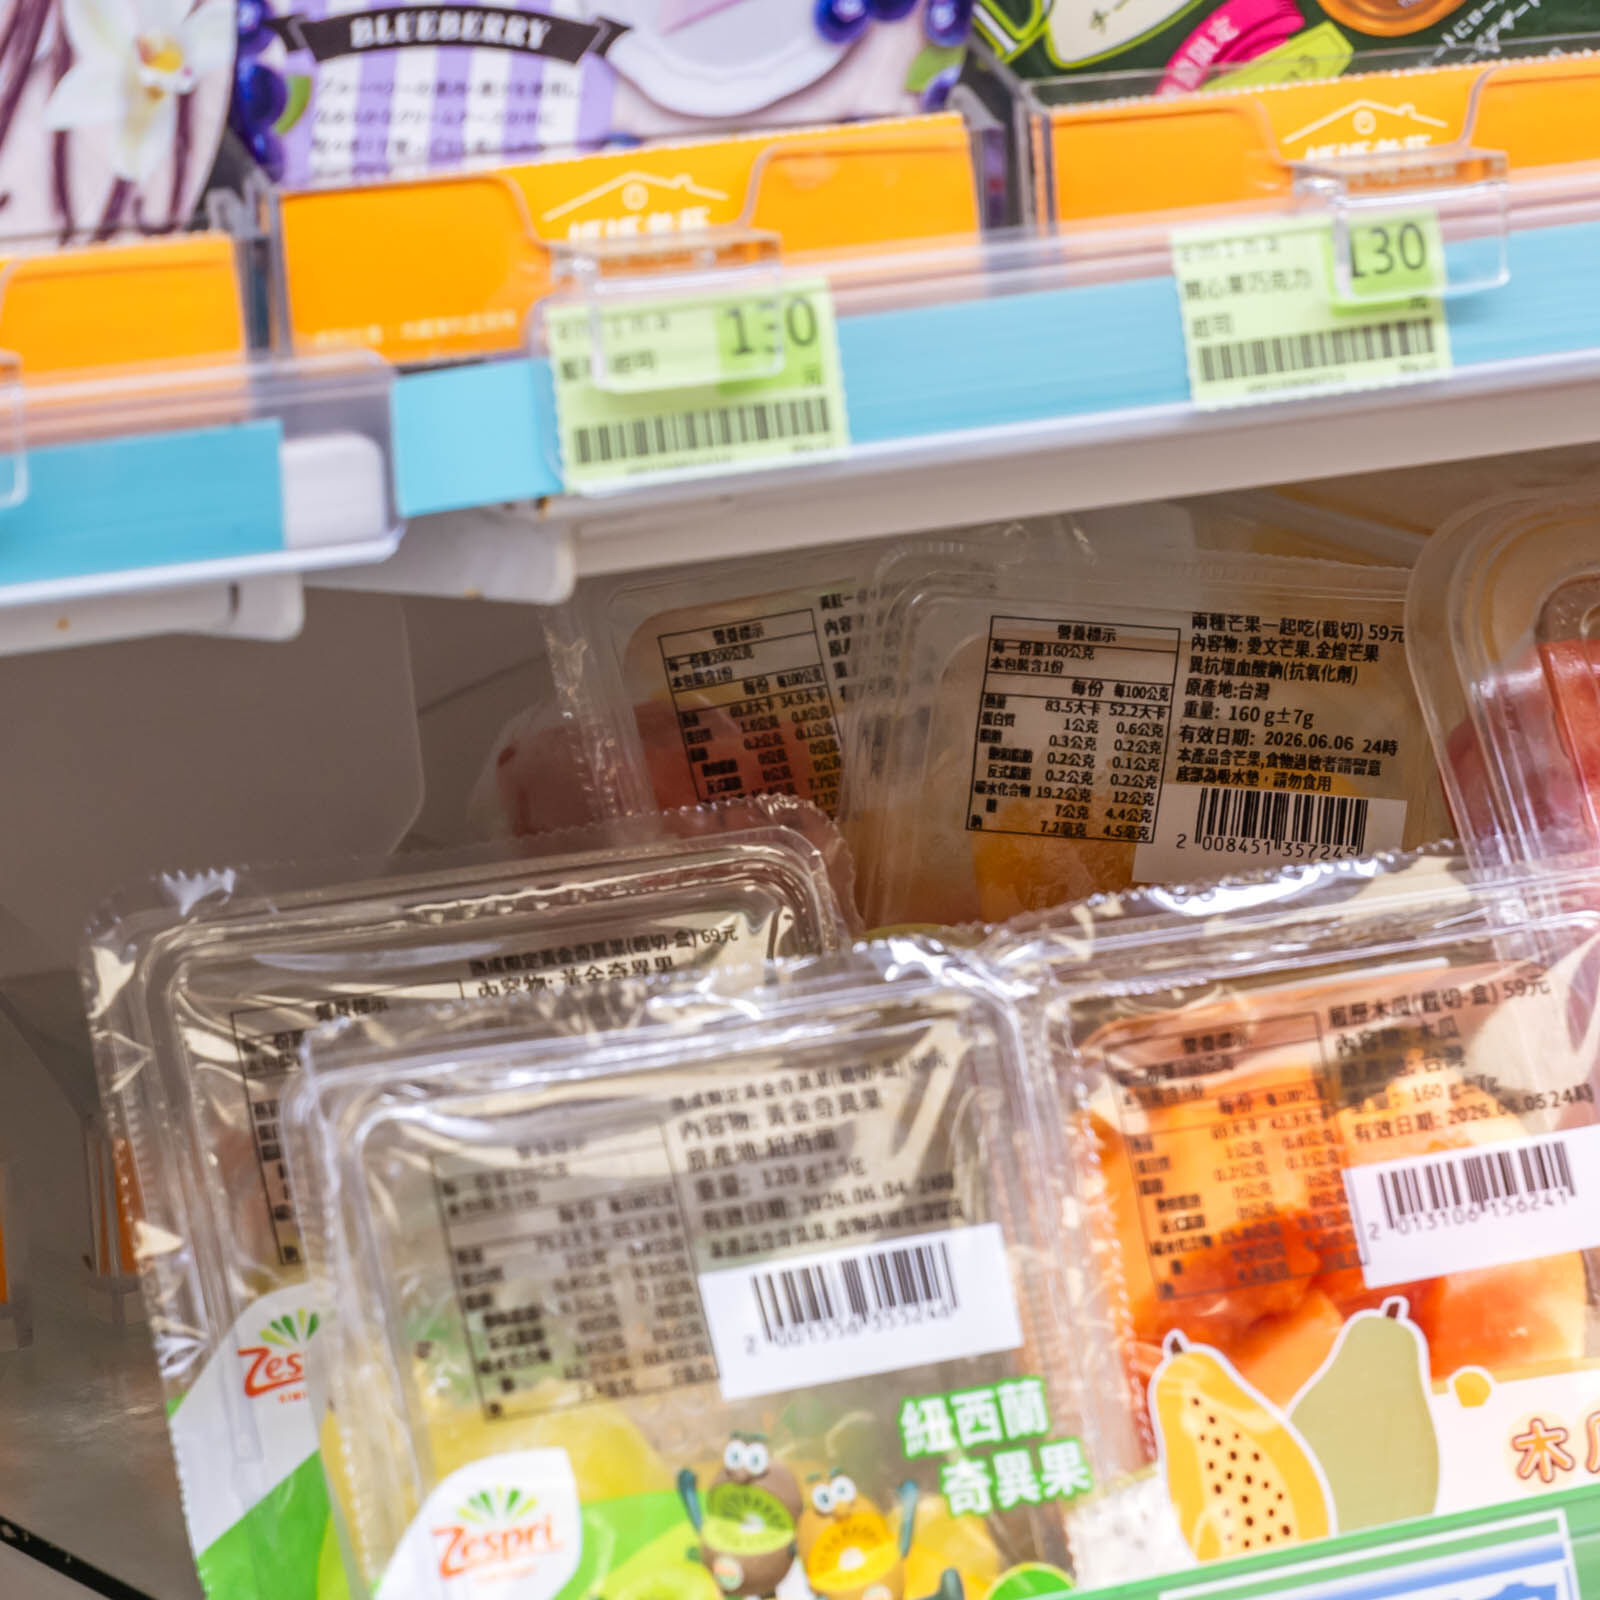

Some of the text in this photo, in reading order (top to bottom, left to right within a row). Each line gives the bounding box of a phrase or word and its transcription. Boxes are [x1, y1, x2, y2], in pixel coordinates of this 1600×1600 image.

[349, 9, 551, 51] BLUEBERRY
[1351, 222, 1426, 279] 130
[1057, 624, 1117, 643] 營養標示
[1191, 633, 1244, 654] 內容物:
[1368, 623, 1405, 643] 59元
[1185, 678, 1270, 701] 原產地:台灣
[1182, 700, 1260, 723] 重量: 160
[1178, 724, 1399, 756] 有效日期: 2026.06.06 24時
[1201, 832, 1273, 856] 008451
[1503, 978, 1550, 998] 59元
[898, 1377, 1050, 1457] 紐西蘭
[938, 1439, 1094, 1517] 奇異果
[432, 1514, 557, 1580] Zespri
